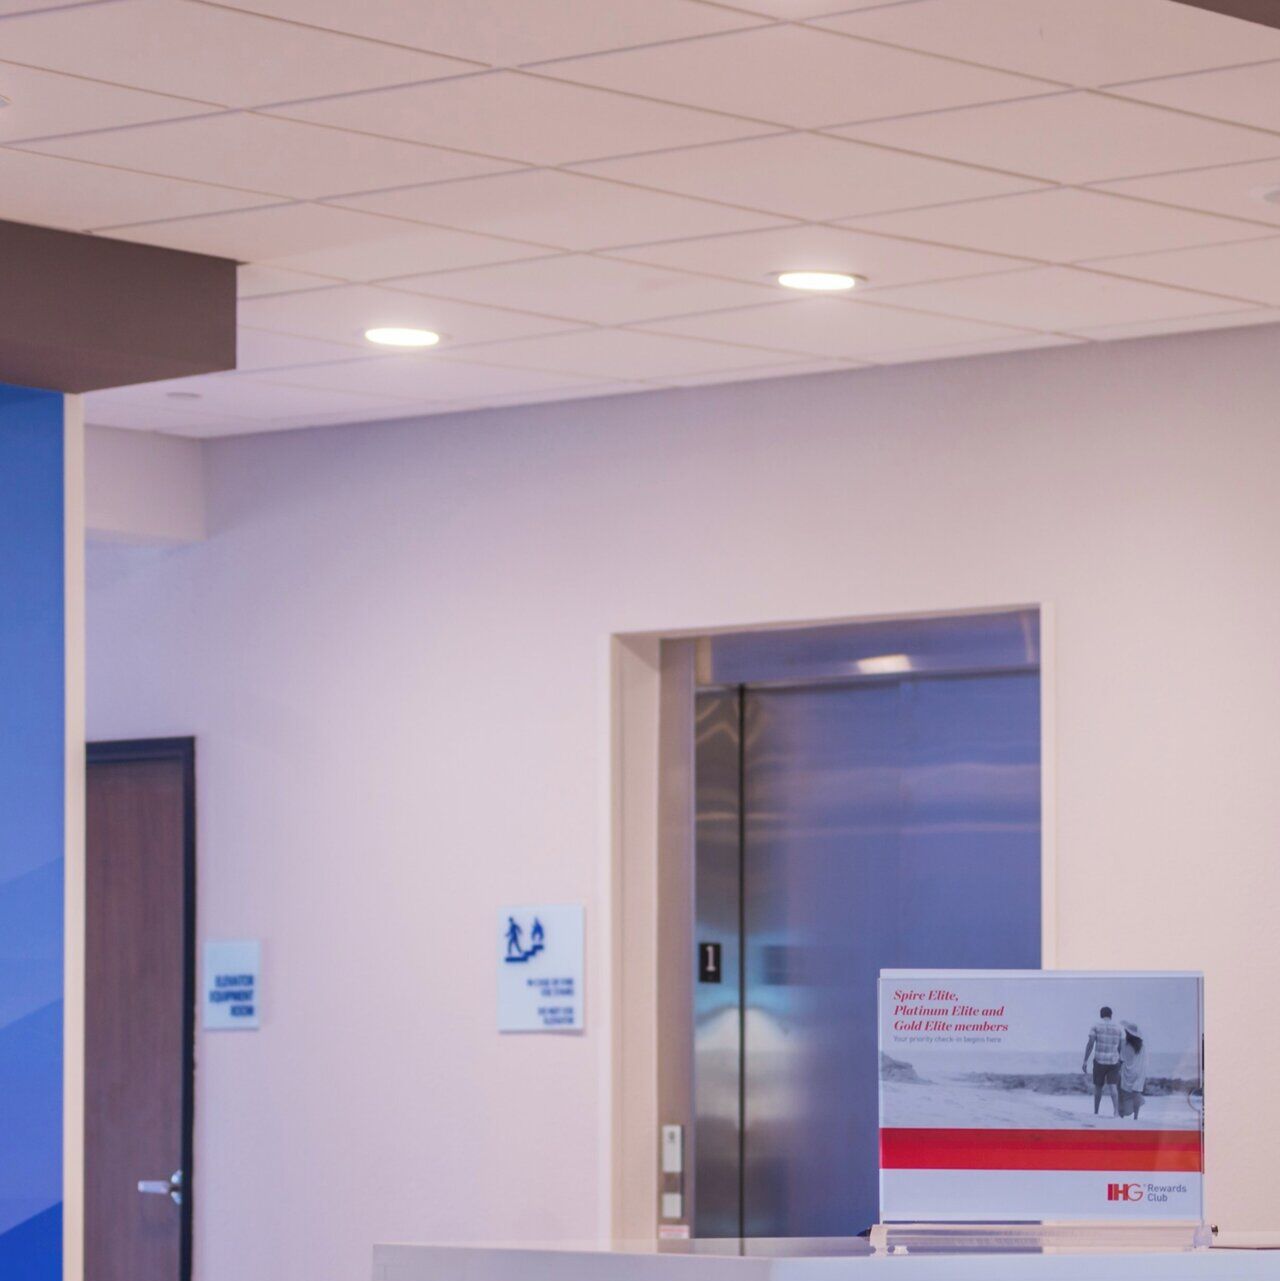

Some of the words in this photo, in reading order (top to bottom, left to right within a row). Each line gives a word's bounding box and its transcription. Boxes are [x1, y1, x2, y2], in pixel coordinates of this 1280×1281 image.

[705, 945, 716, 972] 1
[893, 989, 926, 1002] Spire
[928, 990, 959, 1001] Elite,
[893, 1005, 949, 1016] Platinum
[951, 1006, 980, 1016] Elite
[981, 1005, 1005, 1017] and
[894, 1020, 922, 1031] Gold
[924, 1020, 952, 1031] Elite
[954, 1021, 1009, 1032] members
[1147, 1183, 1187, 1193] Rewards
[1147, 1193, 1168, 1202] Club
